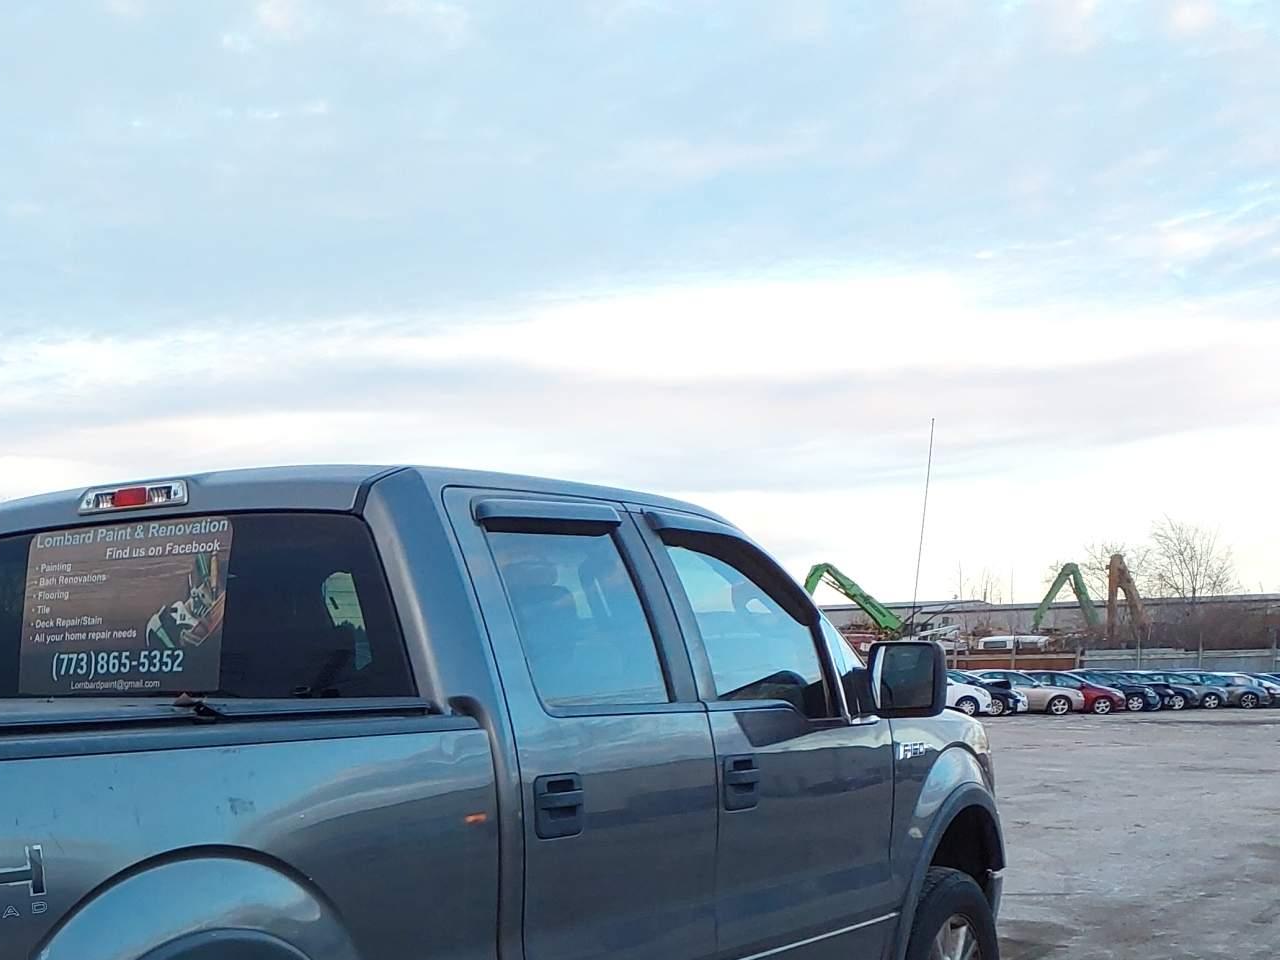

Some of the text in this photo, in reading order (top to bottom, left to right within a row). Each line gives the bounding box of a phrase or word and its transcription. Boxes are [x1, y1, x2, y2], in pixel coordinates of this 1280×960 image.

[36, 519, 228, 549] Lombard Paint & Renovation
[106, 539, 220, 560] Find us on Facebook
[40, 562, 72, 573] Painting
[39, 573, 107, 586] Bath Renovations
[38, 590, 69, 600] Flooring
[37, 605, 51, 615] Tile
[35, 615, 103, 629] Deck Repair/Stain
[34, 628, 137, 644] All your home repair needs
[52, 650, 183, 681] (773)865-5352
